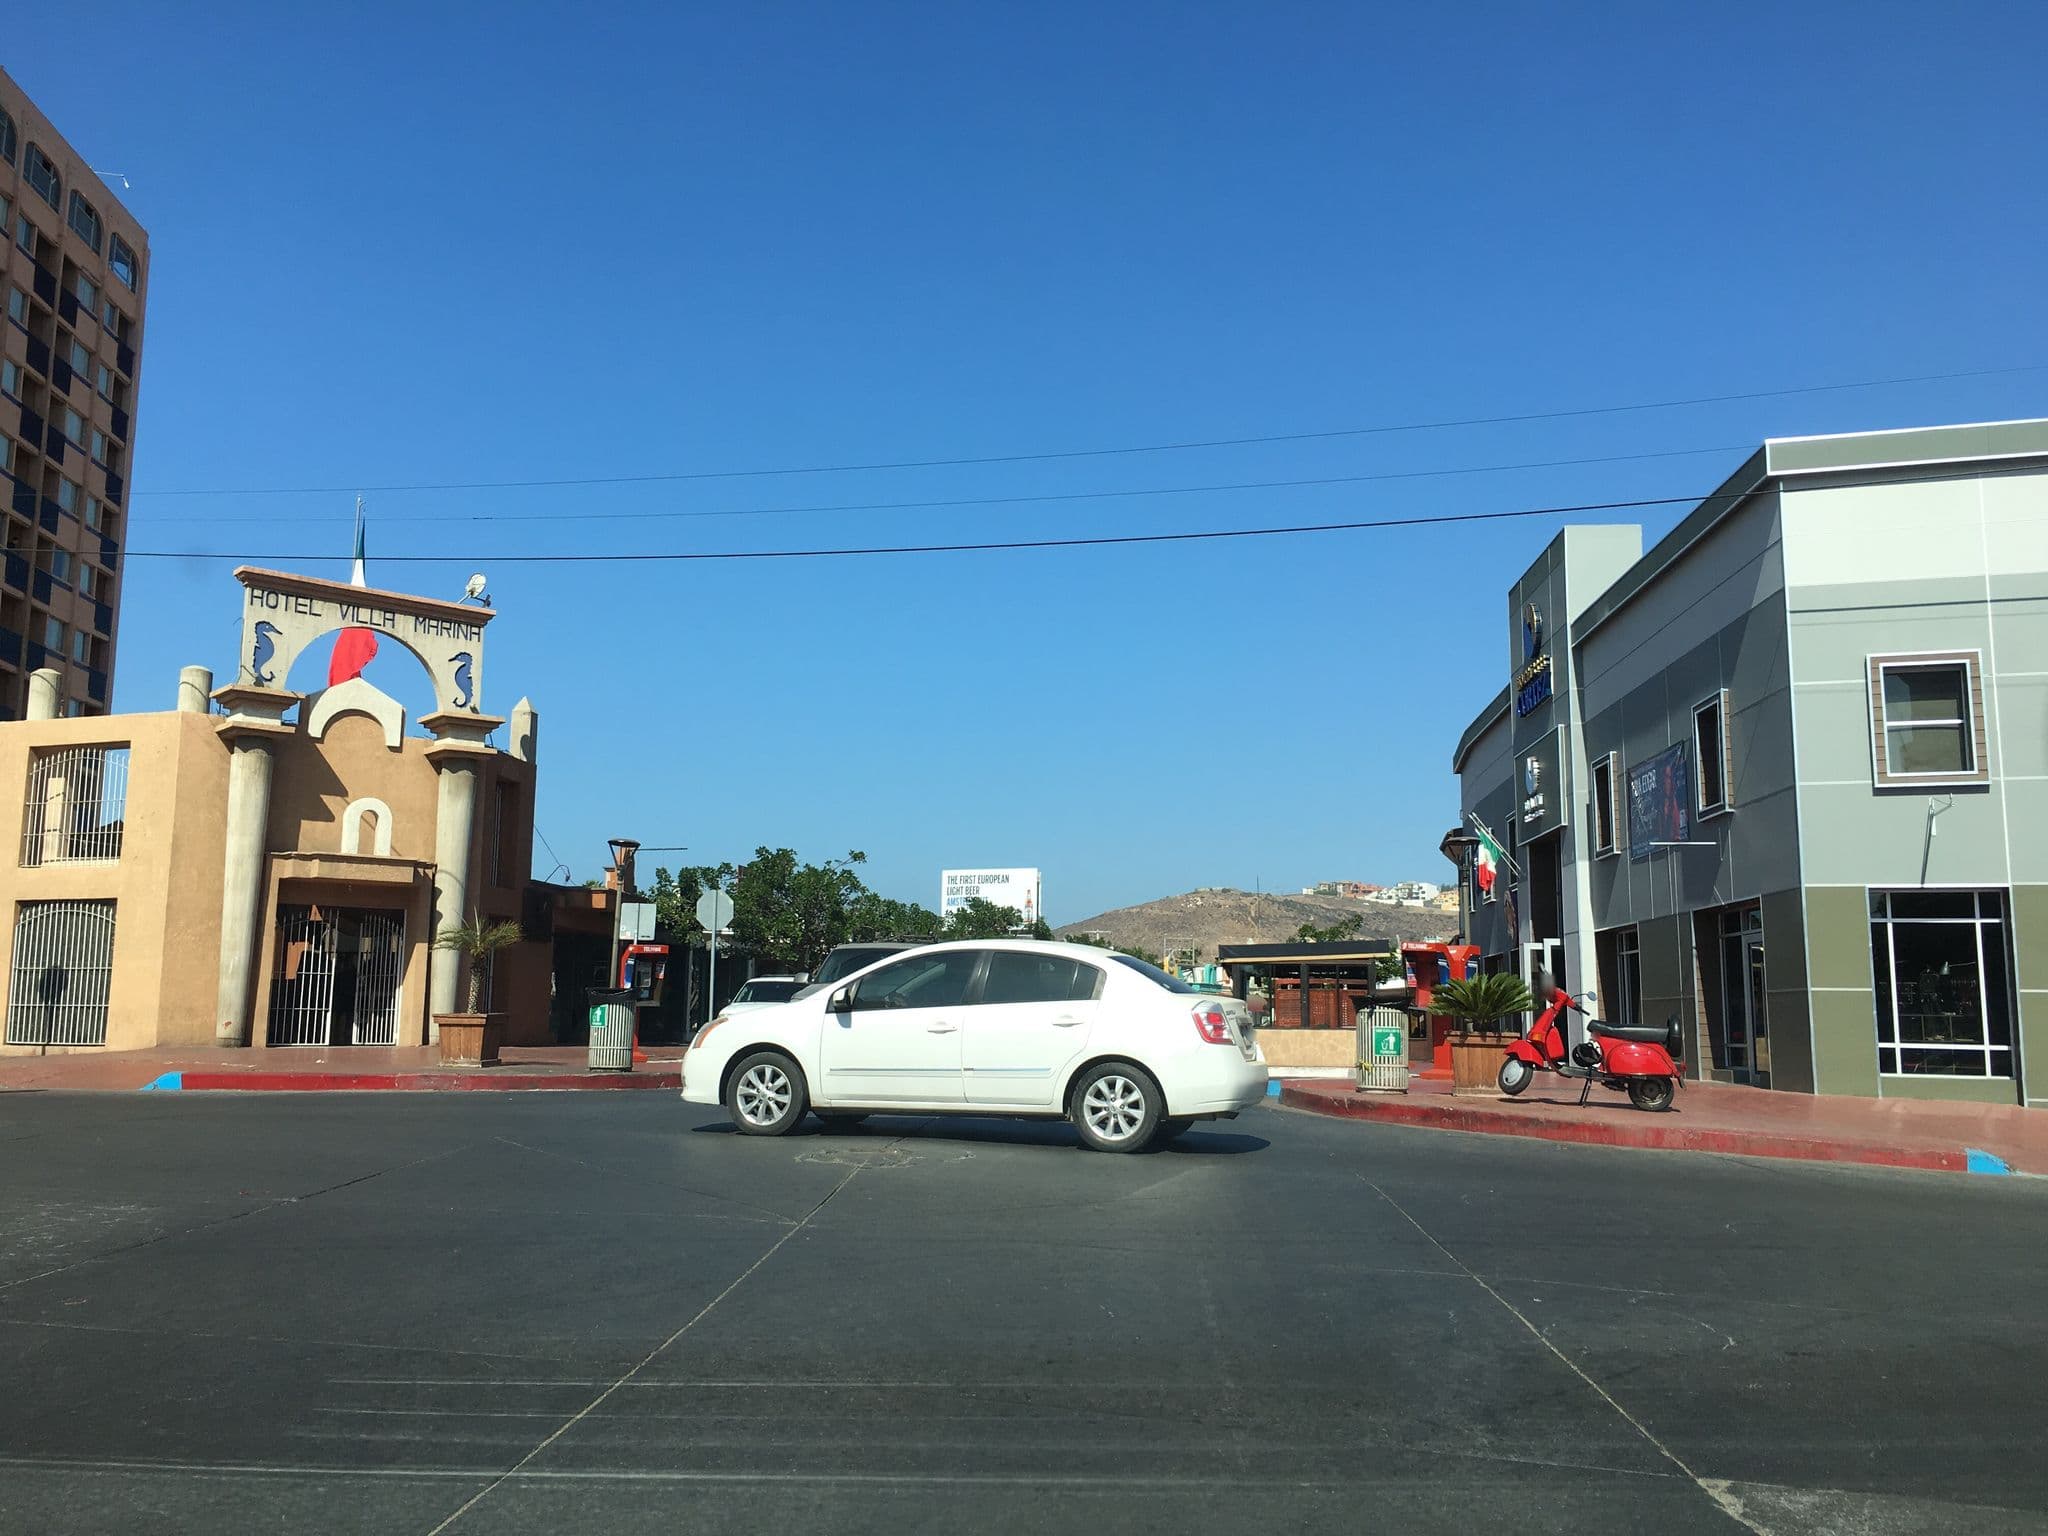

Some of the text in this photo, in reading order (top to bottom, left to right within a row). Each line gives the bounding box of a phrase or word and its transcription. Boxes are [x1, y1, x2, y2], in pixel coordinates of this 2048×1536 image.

[250, 588, 481, 642] HOTEL VILLA MARINA
[947, 874, 1010, 885] THE FIRST EUROPEAN
[946, 885, 980, 896] LIGHT BEER
